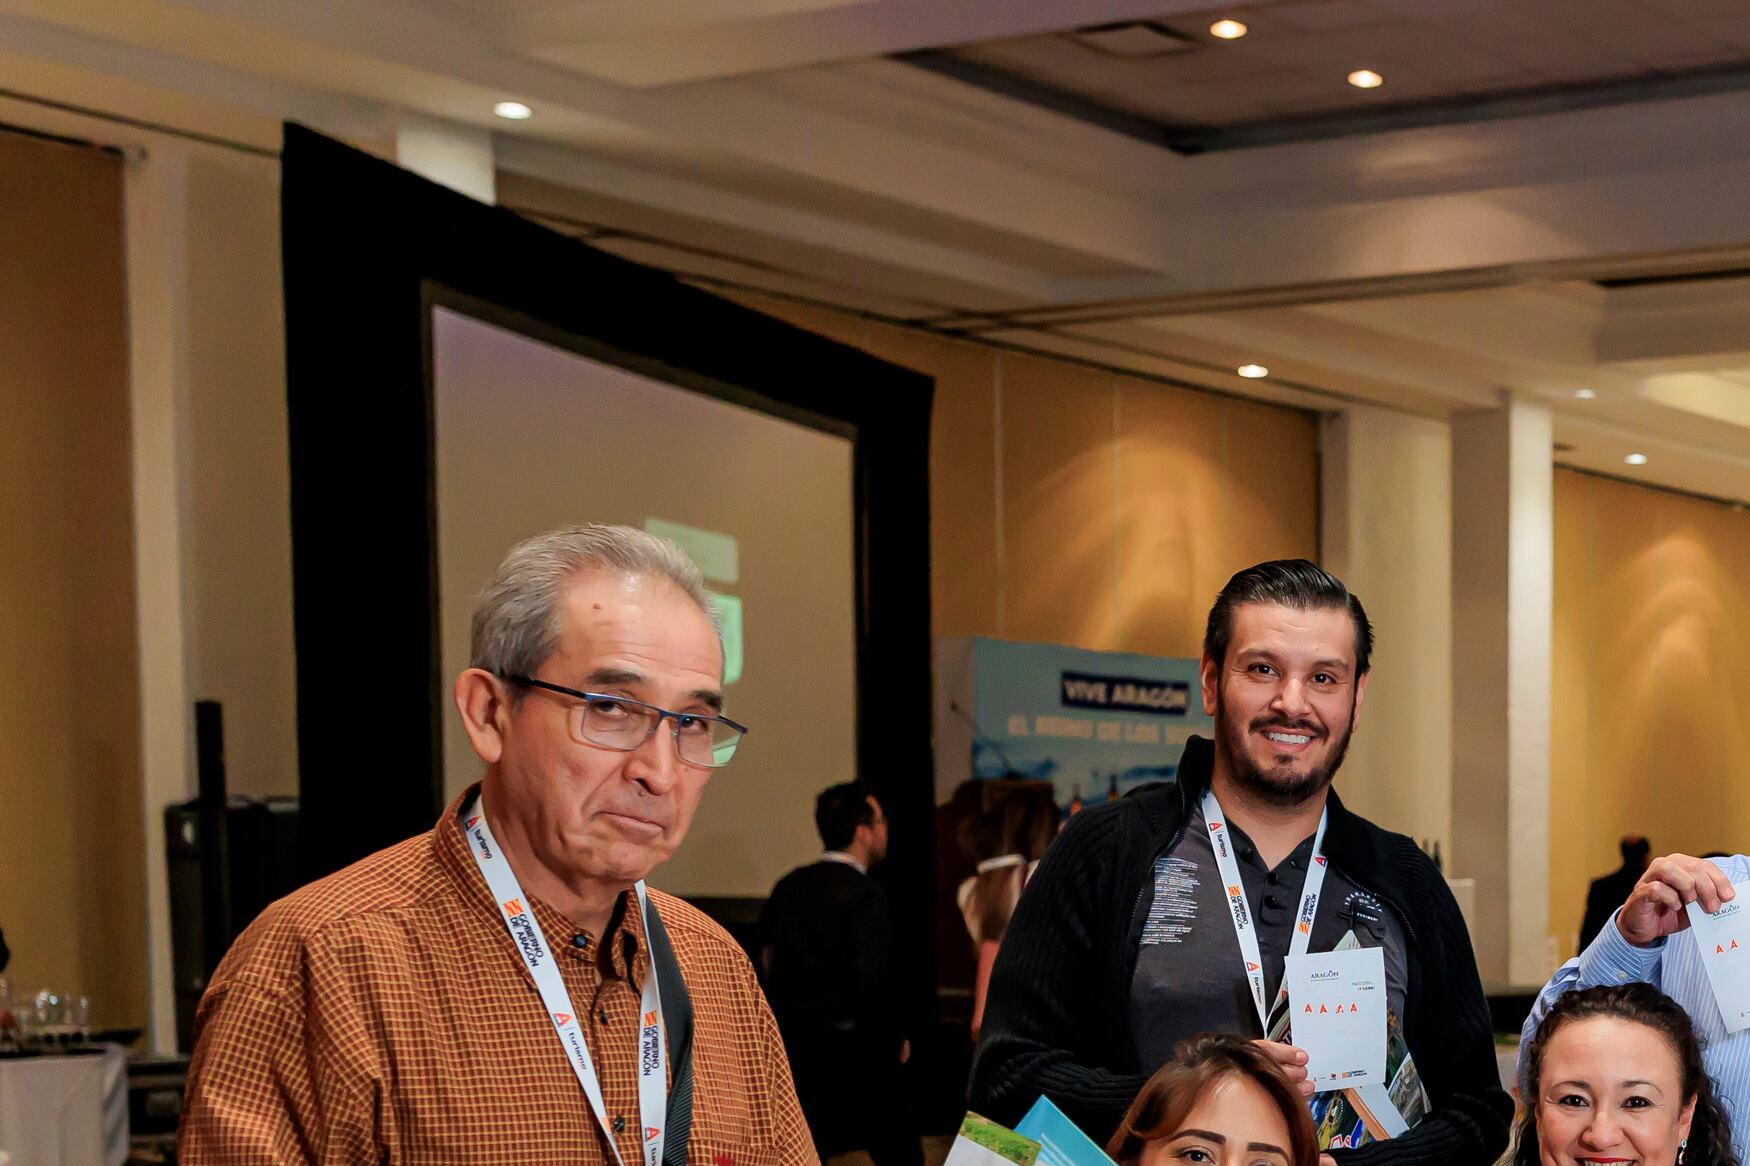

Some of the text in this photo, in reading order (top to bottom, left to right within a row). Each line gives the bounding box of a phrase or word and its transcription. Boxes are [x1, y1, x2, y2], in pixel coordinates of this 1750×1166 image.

[1064, 679, 1107, 704] VIVE
[474, 827, 493, 860] turismo
[1217, 834, 1228, 858] turismo
[1230, 896, 1244, 930] DE ARAGÓN
[1237, 895, 1249, 926] GOBIERNO
[1301, 894, 1312, 924] GOBIERNO
[1307, 893, 1317, 917] ARAGÓN
[510, 916, 539, 968] DE ARAGÓN
[518, 913, 545, 959] GOBIERNO
[568, 1031, 588, 1070] turismo
[643, 1027, 652, 1077] DE ARAGÓN
[650, 1025, 660, 1070] GOBIERNO
